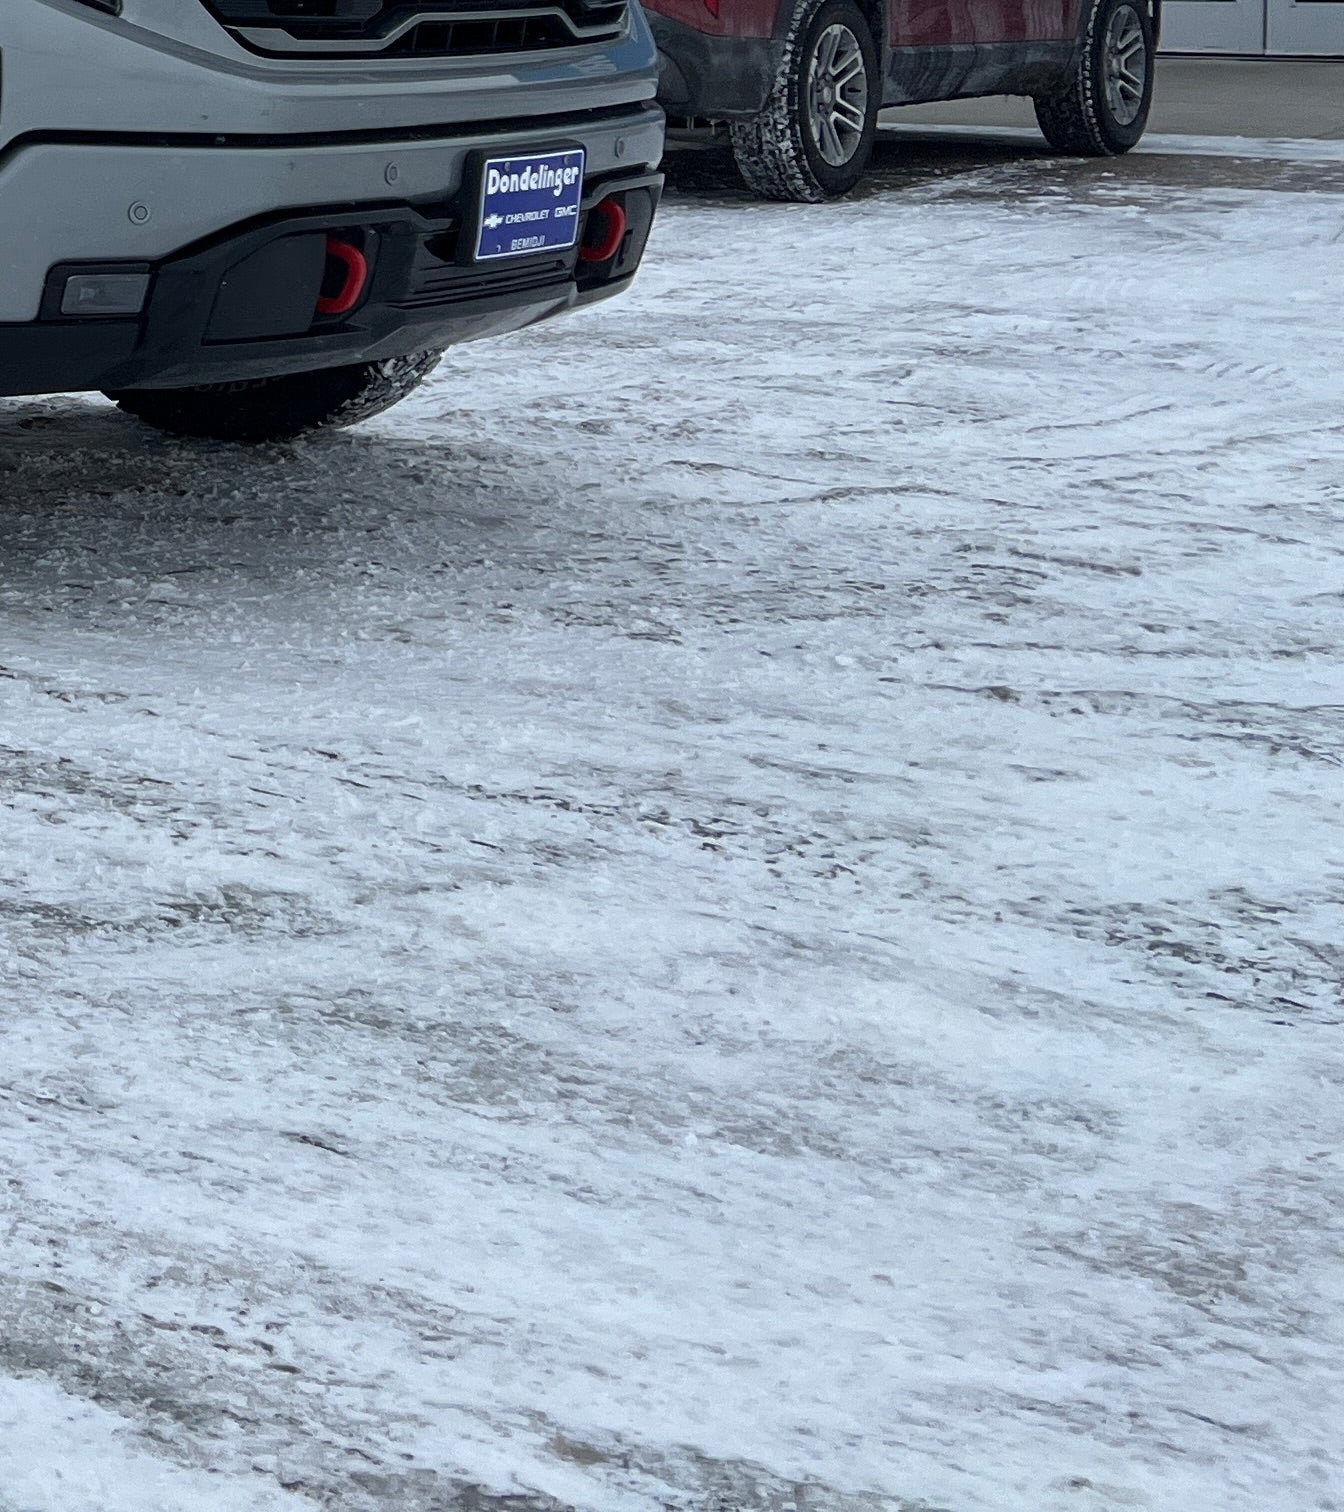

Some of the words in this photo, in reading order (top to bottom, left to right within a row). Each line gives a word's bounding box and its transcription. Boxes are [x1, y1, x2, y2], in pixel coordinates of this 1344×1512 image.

[487, 165, 580, 197] Dondelinger
[505, 209, 550, 225] CHEVROLET
[554, 205, 578, 218] GMC
[511, 235, 546, 251] BEMIDJI
